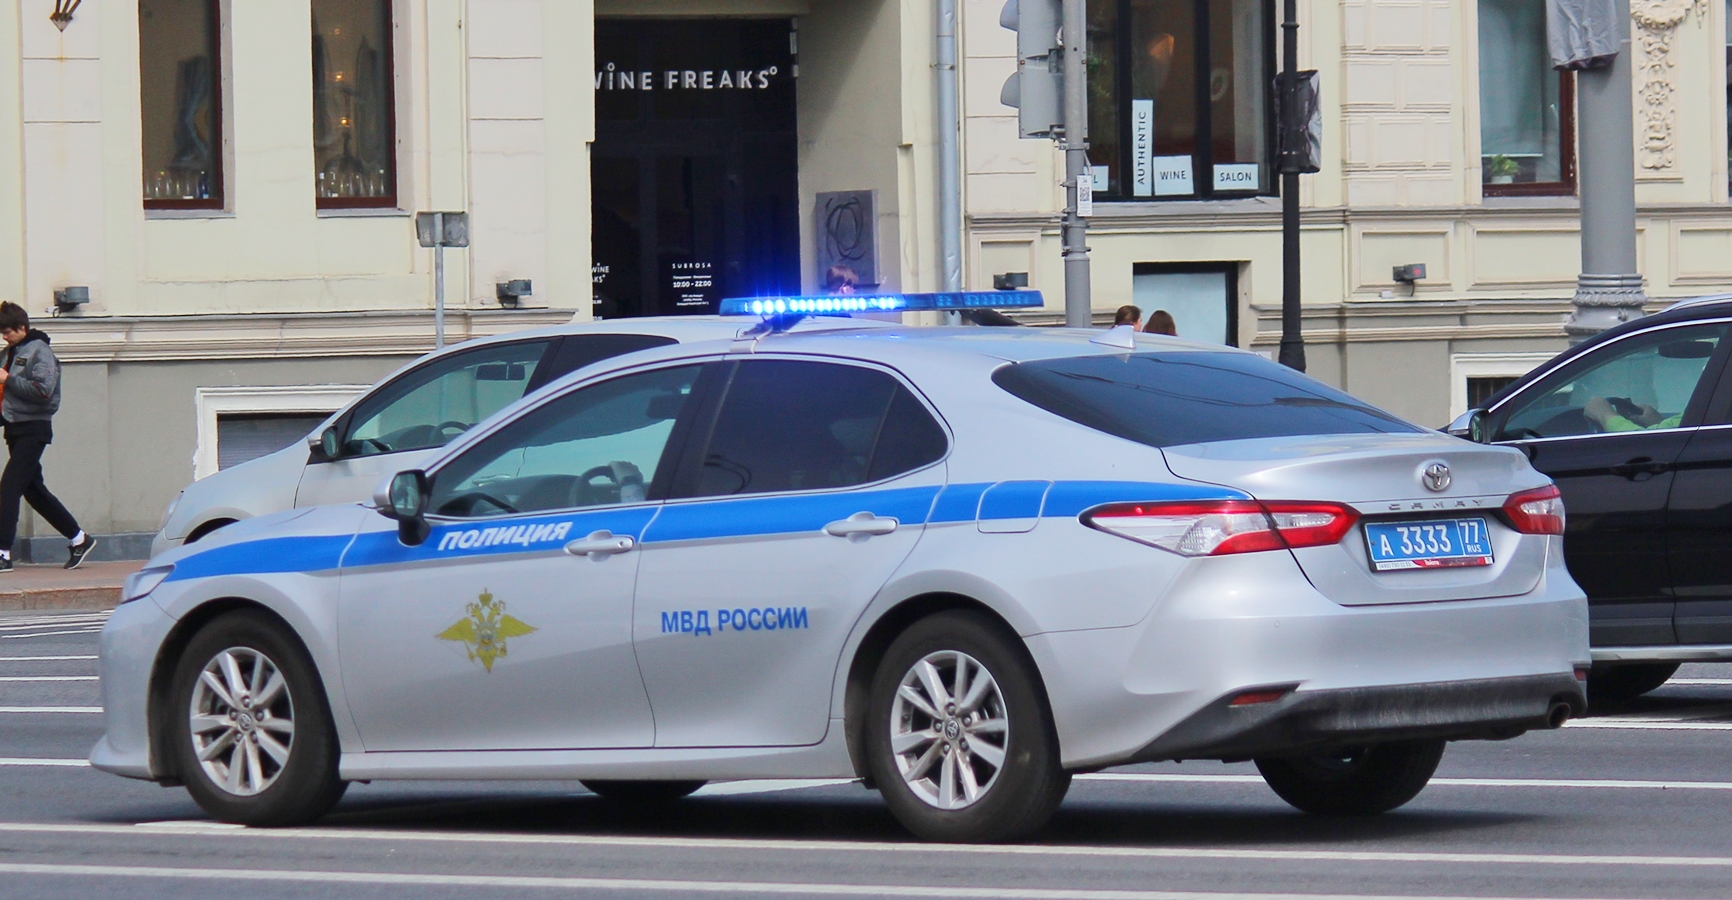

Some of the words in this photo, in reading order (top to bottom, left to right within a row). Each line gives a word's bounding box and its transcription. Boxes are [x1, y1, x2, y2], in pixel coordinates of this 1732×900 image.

[1137, 111, 1147, 185] AUTHENTIC
[1160, 170, 1187, 181] WINE
[1219, 172, 1252, 182] SALON
[438, 521, 573, 551] ПОЛИЦИЯ
[1396, 524, 1452, 555] 3333
[1459, 521, 1479, 544] 77
[1467, 544, 1482, 553] RUS
[661, 610, 712, 637] МВД
[718, 606, 808, 631] РОССИИ
